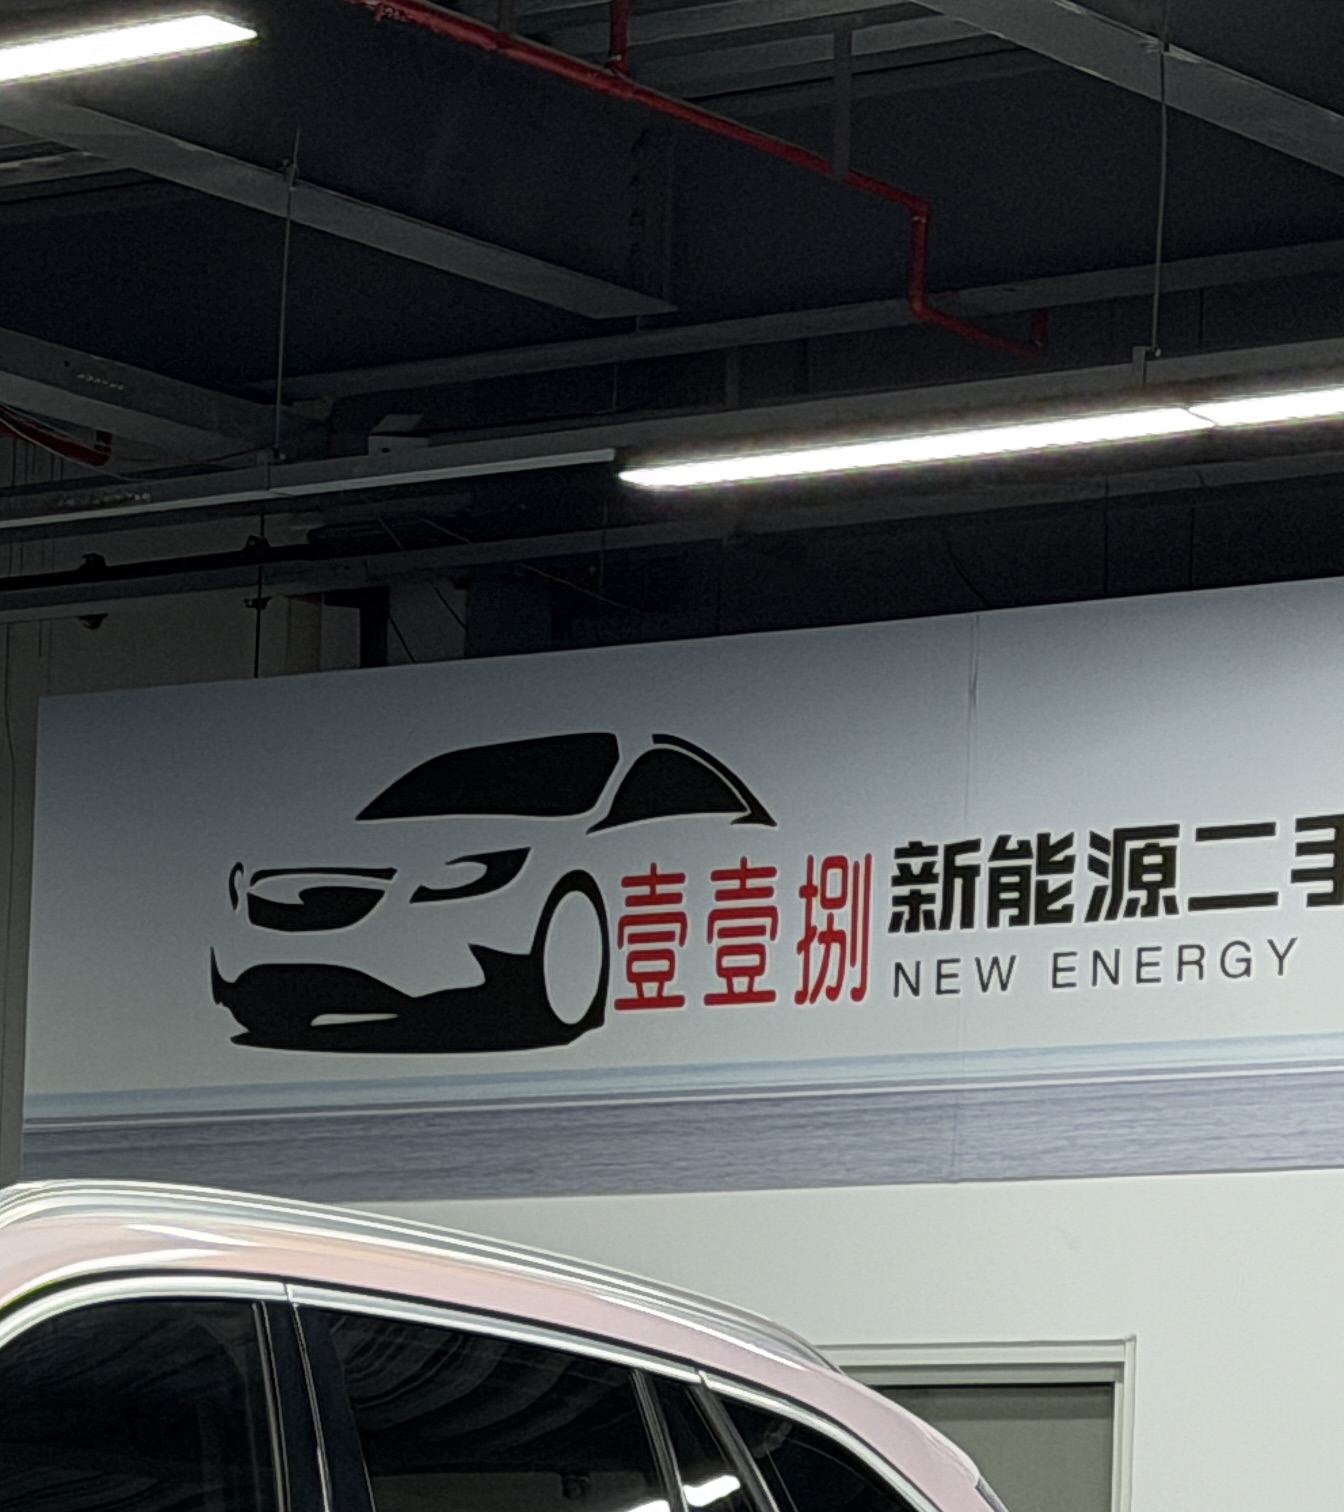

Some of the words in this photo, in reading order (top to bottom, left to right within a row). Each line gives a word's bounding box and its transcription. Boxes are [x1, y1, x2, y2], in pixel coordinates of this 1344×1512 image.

[613, 853, 874, 1011] 壹壹捌
[893, 954, 1018, 998] NEW
[1051, 936, 1299, 990] ENERGY
